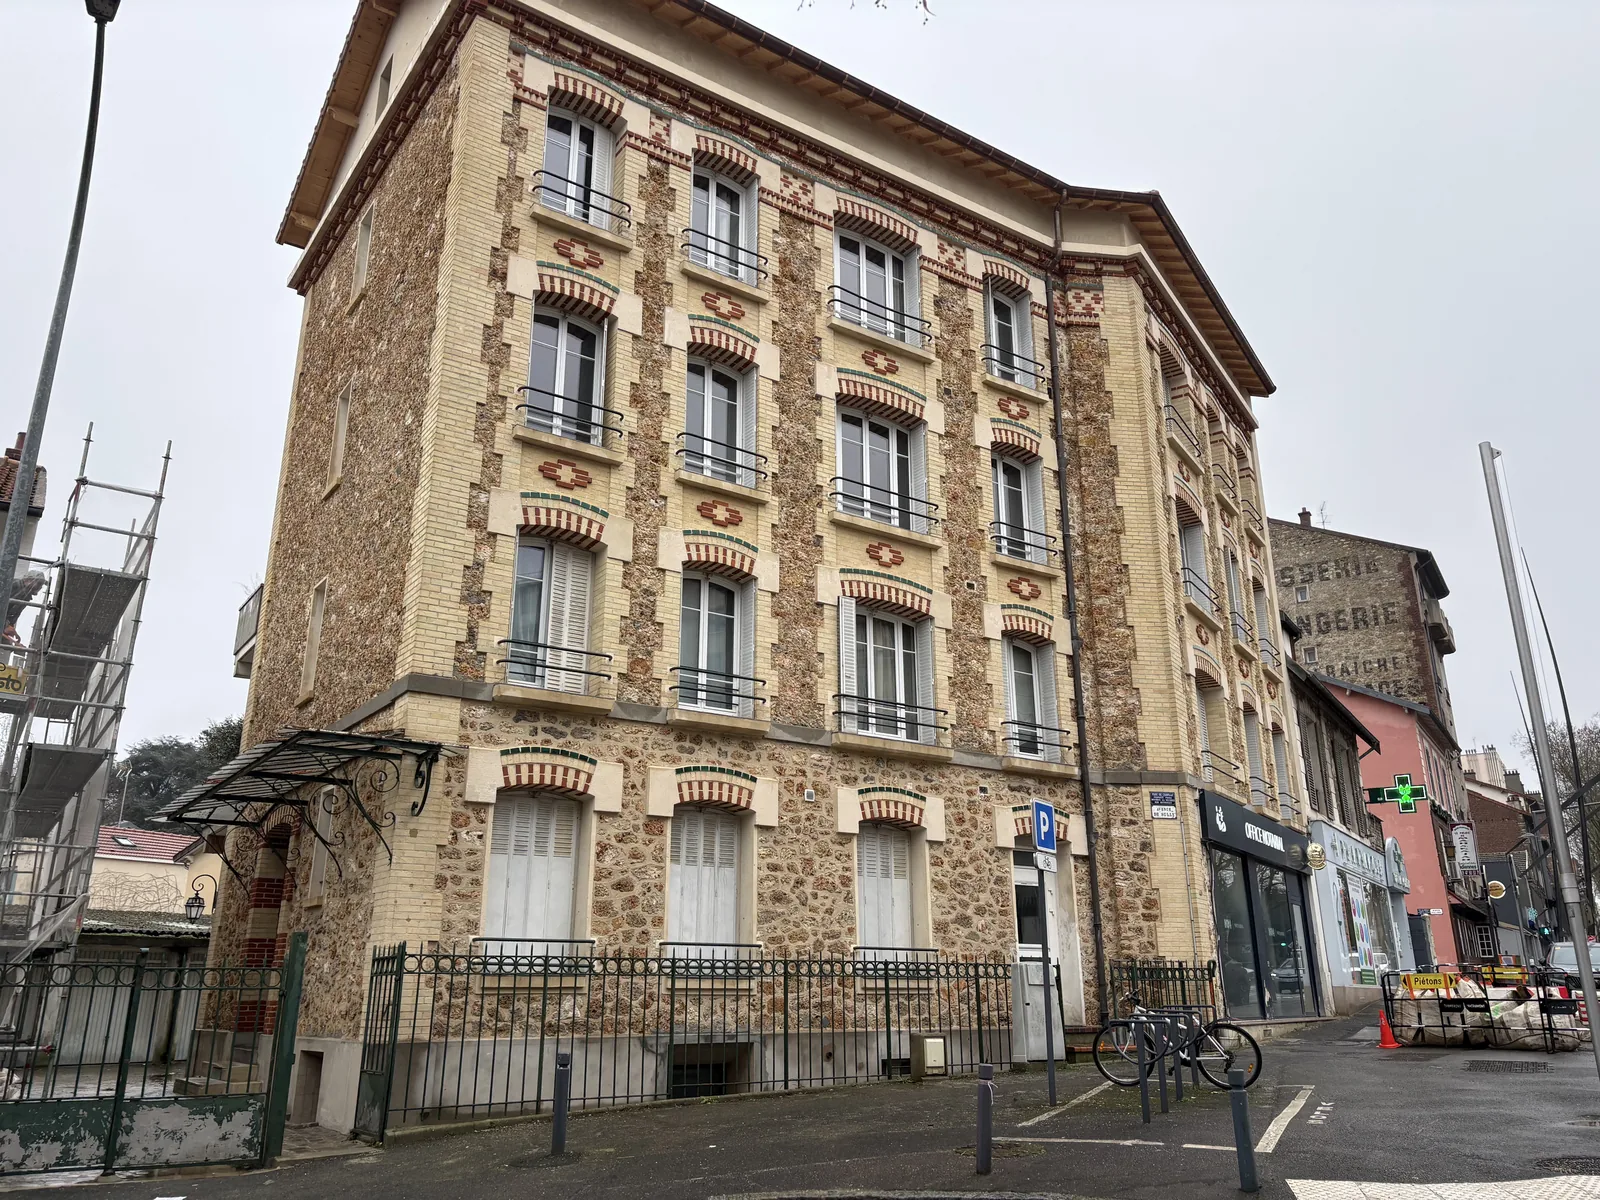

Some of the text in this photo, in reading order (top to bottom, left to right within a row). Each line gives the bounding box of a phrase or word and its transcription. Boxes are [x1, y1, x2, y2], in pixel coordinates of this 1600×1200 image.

[1278, 555, 1379, 587] SSERIE
[1297, 602, 1398, 636] NGERIE
[1040, 810, 1050, 840] P
[1244, 822, 1263, 844] OFFICE
[1413, 976, 1442, 986] Piétons
